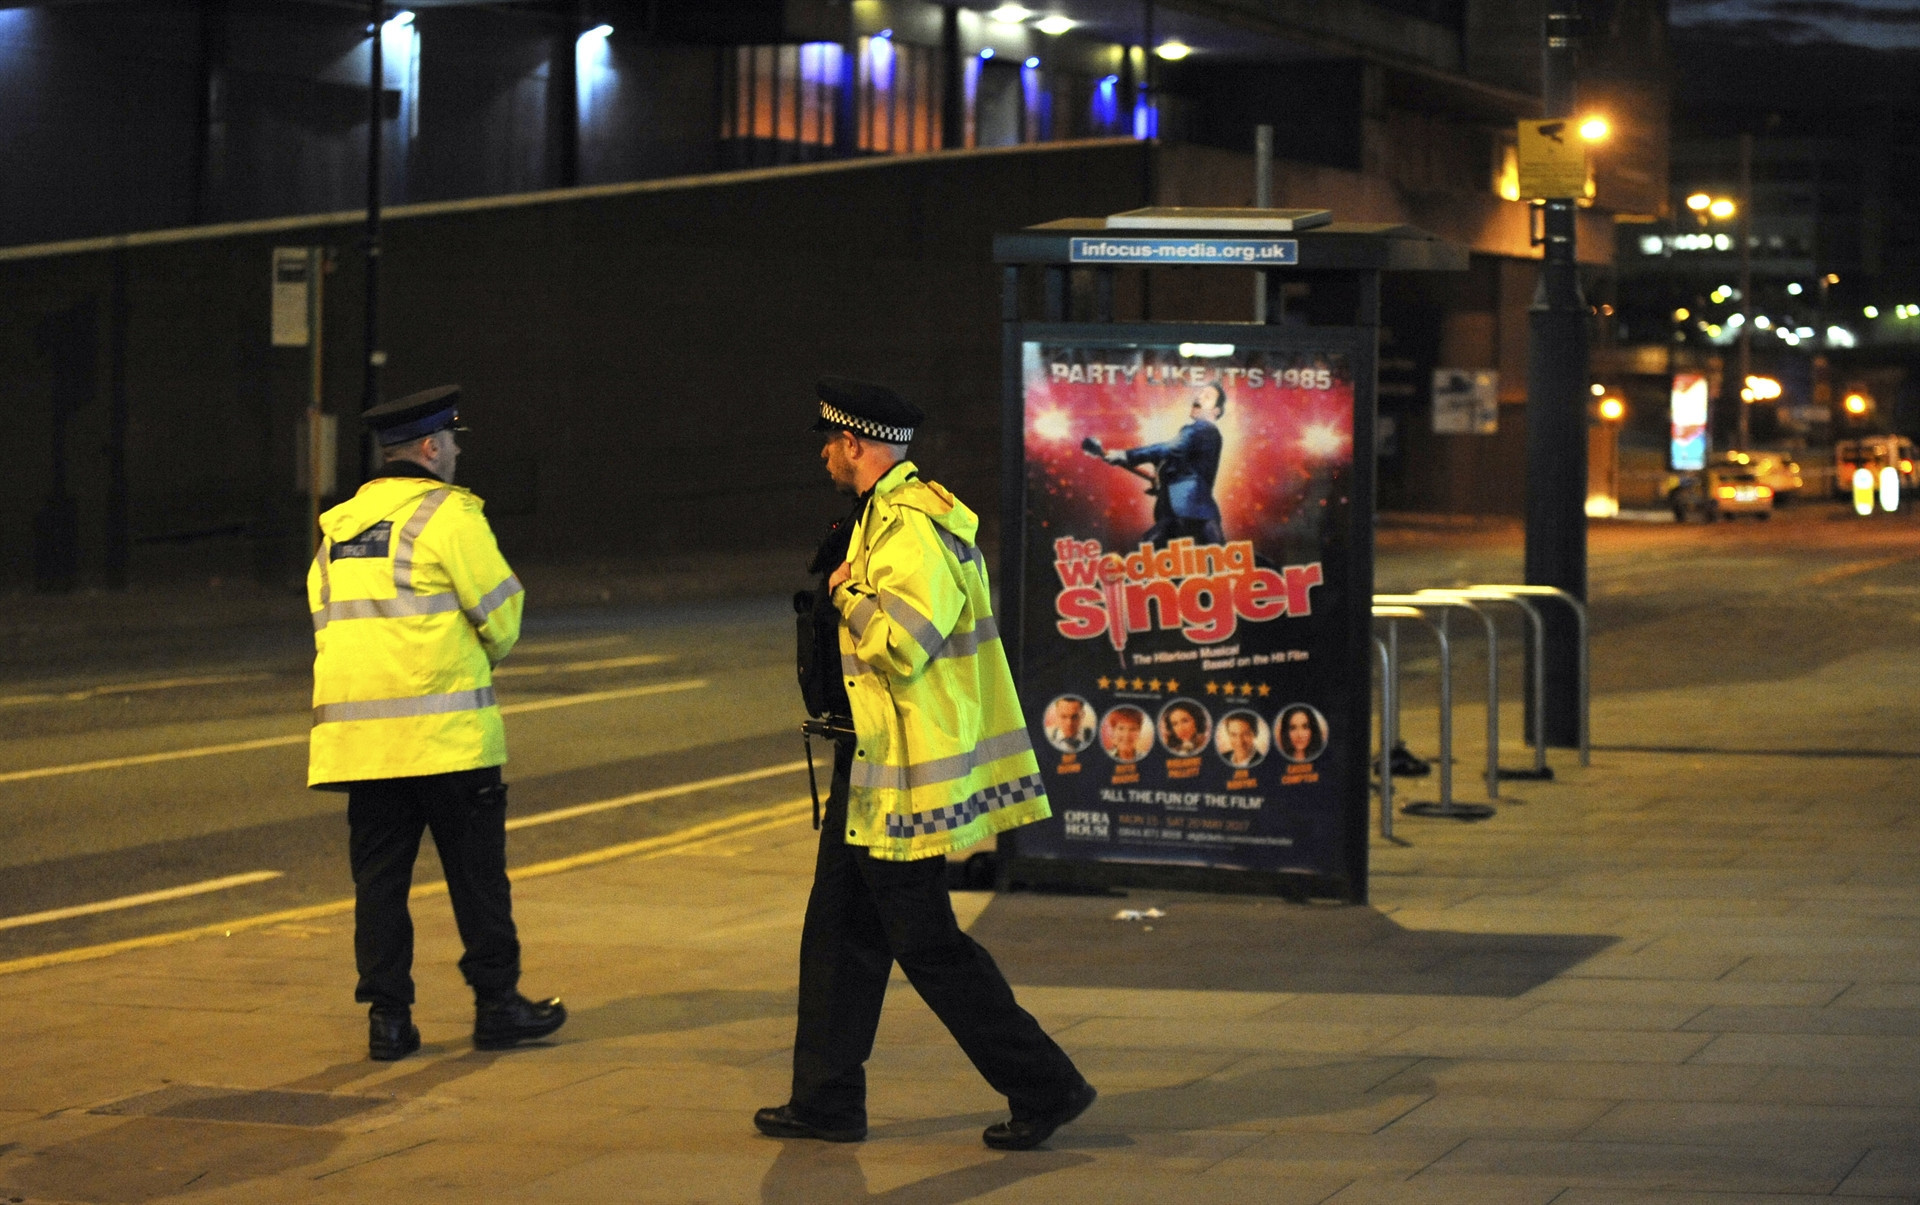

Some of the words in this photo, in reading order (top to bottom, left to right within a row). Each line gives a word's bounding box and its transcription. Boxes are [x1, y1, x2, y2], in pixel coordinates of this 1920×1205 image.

[1081, 241, 1285, 261] infocus-media.org.uk
[1051, 362, 1139, 386] PARTY
[1146, 365, 1206, 388] LIKE
[1272, 368, 1332, 391] 1985
[1054, 536, 1102, 562] the
[1054, 537, 1254, 588] wedding
[1132, 653, 1152, 665] The
[1237, 656, 1251, 667] on
[1253, 654, 1269, 666] the
[1128, 790, 1153, 804] THE
[1155, 791, 1182, 806] FUN
[1184, 792, 1201, 806] OF
[1203, 794, 1228, 808] THE
[1063, 809, 1110, 825] OPERA
[1065, 823, 1109, 837] HOUSE
